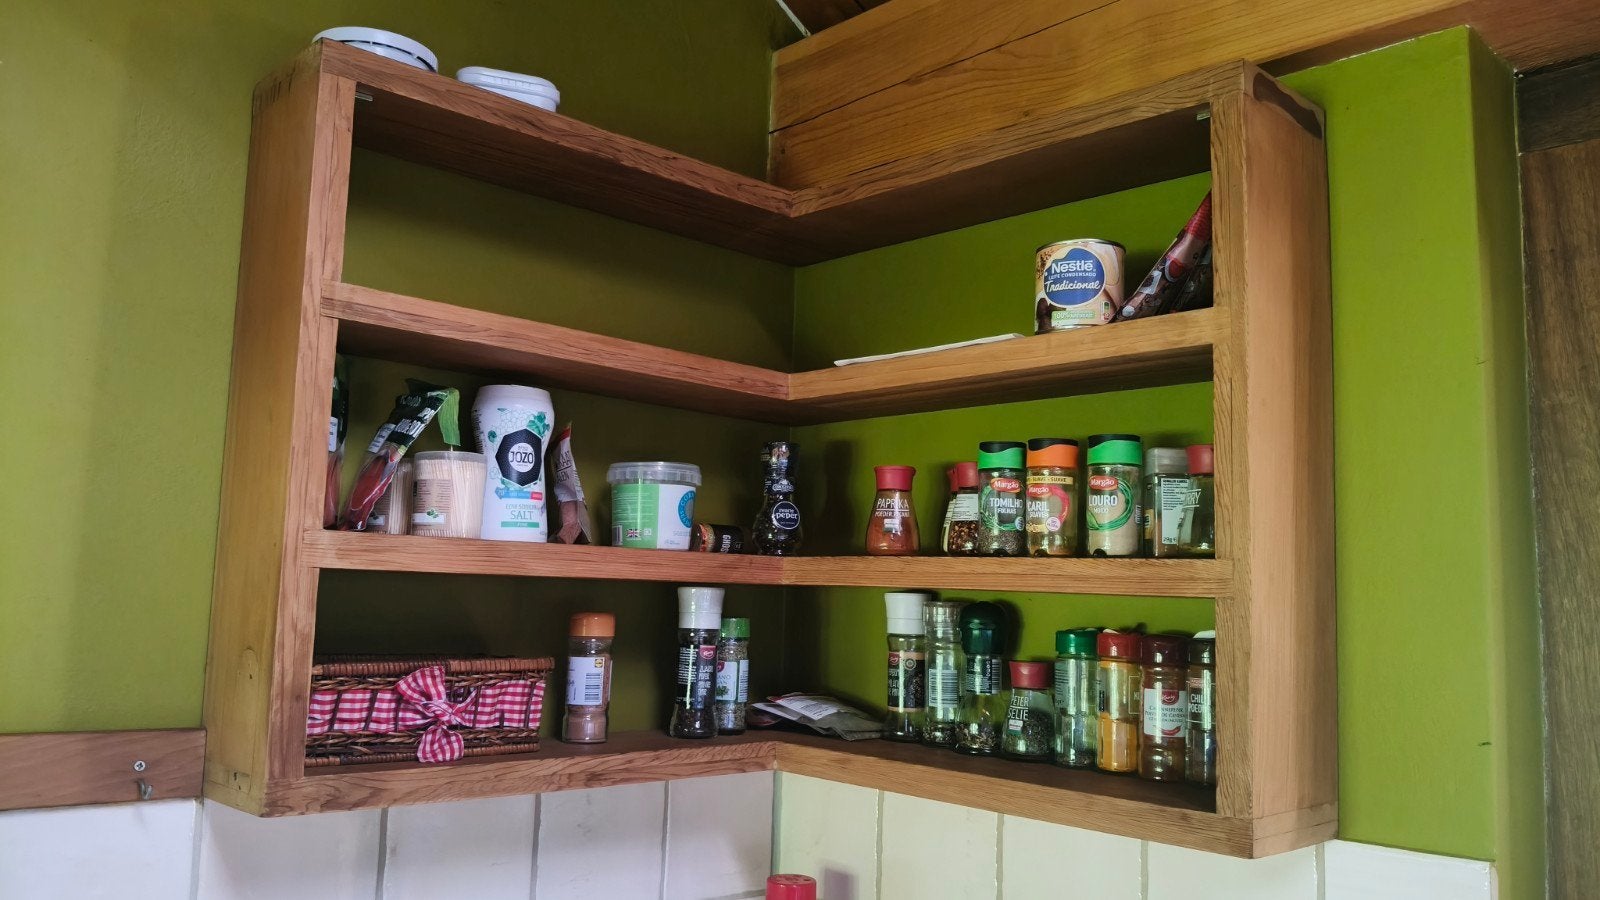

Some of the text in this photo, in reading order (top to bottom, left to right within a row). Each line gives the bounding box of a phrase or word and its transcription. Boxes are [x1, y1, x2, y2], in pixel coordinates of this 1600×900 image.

[1051, 260, 1094, 274] Nestlé
[1044, 280, 1101, 293] Tradicional
[509, 451, 534, 464] JOZO
[993, 480, 1019, 489] Margão
[1090, 479, 1115, 487] Margão
[876, 498, 909, 509] PAPRKA
[990, 498, 1023, 508] TOMILHO
[1088, 494, 1118, 506] LOURO
[1027, 501, 1050, 511] CARIL
[510, 510, 533, 520] SALT
[776, 512, 798, 520] peper
[1190, 694, 1206, 703] CHIL
[1008, 708, 1029, 720] SELIE
